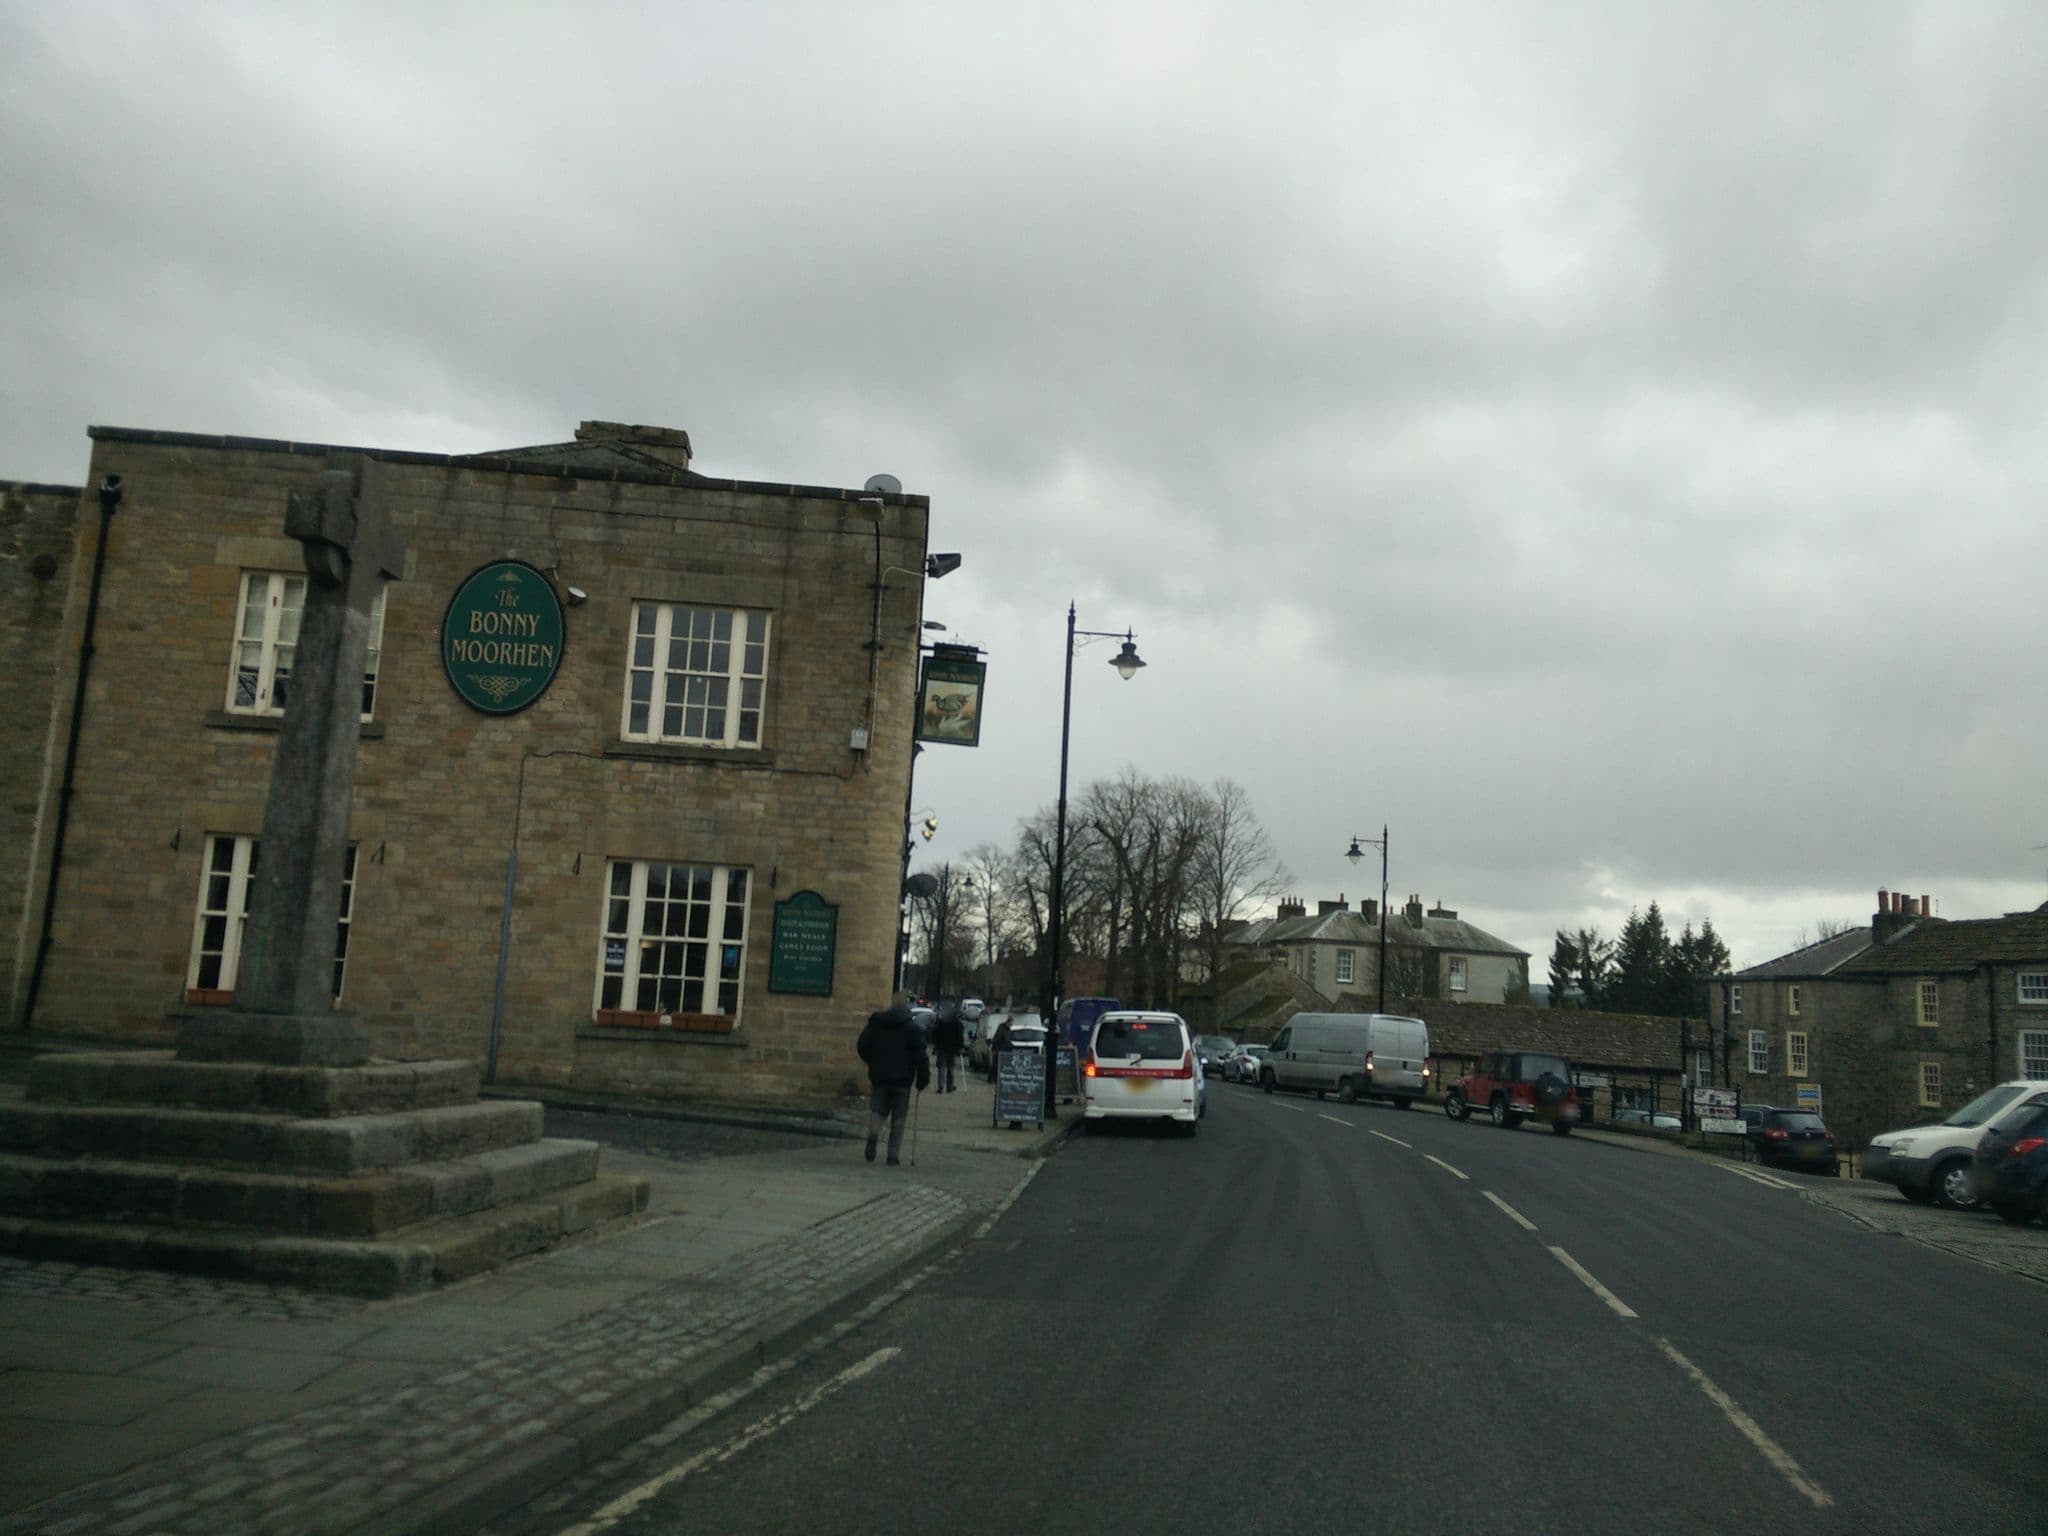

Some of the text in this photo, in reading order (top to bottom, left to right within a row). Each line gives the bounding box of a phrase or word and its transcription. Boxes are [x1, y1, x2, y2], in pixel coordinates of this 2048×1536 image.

[494, 588, 520, 607] The
[469, 610, 541, 637] BONNY
[451, 639, 554, 668] MOORHEN
